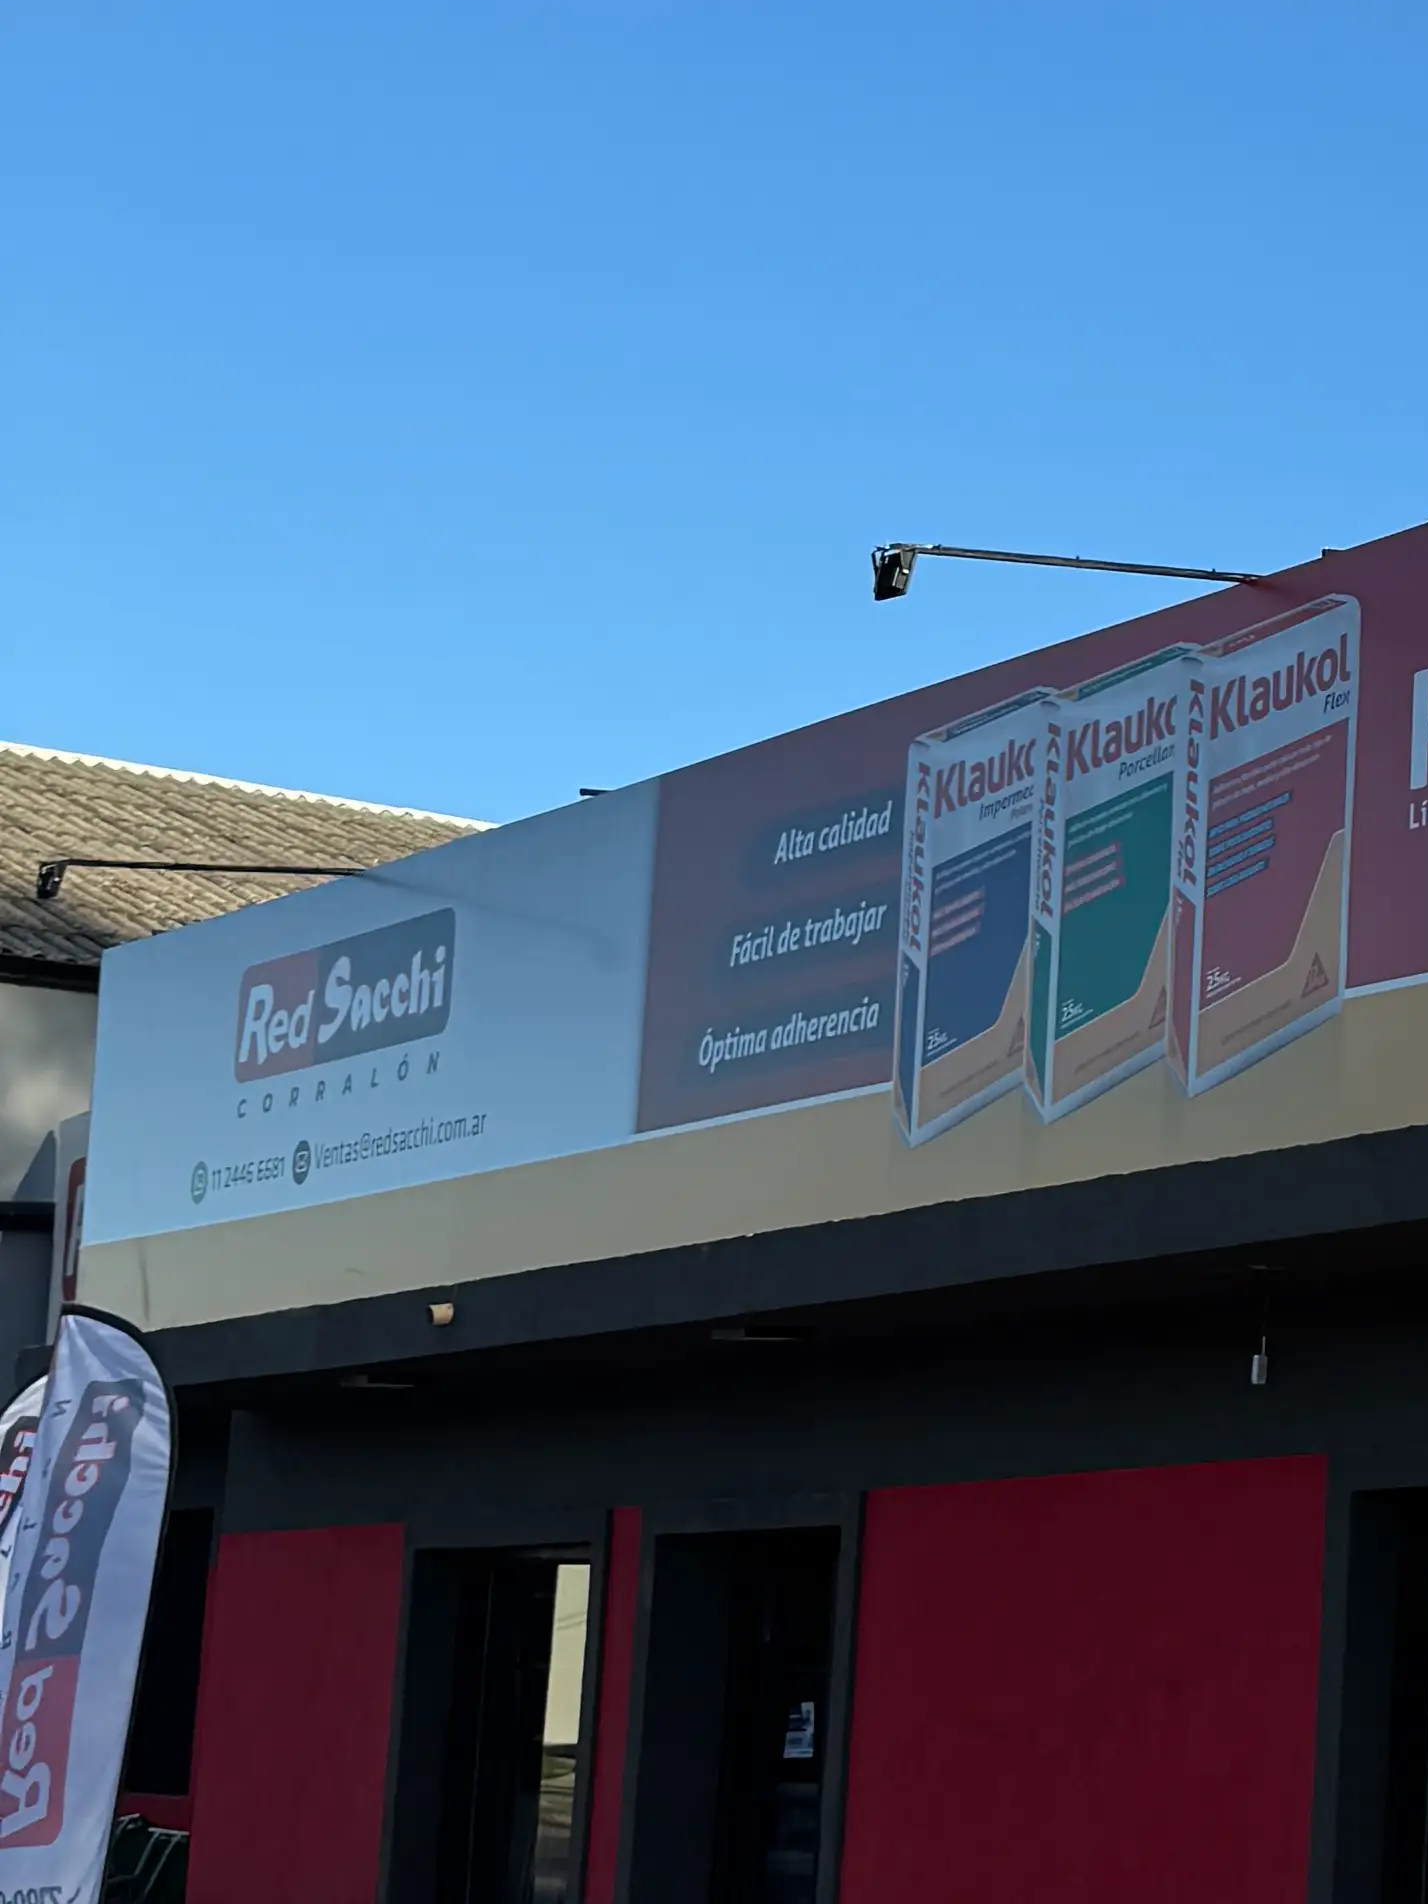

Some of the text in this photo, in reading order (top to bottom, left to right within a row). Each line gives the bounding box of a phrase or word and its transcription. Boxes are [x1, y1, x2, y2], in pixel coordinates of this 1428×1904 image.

[1210, 633, 1350, 741] Klaukol
[1323, 690, 1350, 714] Flex
[1066, 695, 1177, 782] Klauko
[934, 738, 1036, 819] Klauko
[773, 800, 893, 866] Alta calidad
[729, 932, 774, 968] Fácil
[777, 923, 801, 957] de
[803, 902, 886, 949] trabajar
[238, 946, 446, 1066] Red Sacchi
[699, 998, 879, 1072] Óptima adherencia
[237, 1050, 440, 1119] CORRALÓN
[314, 1112, 487, 1170] Ventas@redsacchi.com.ar
